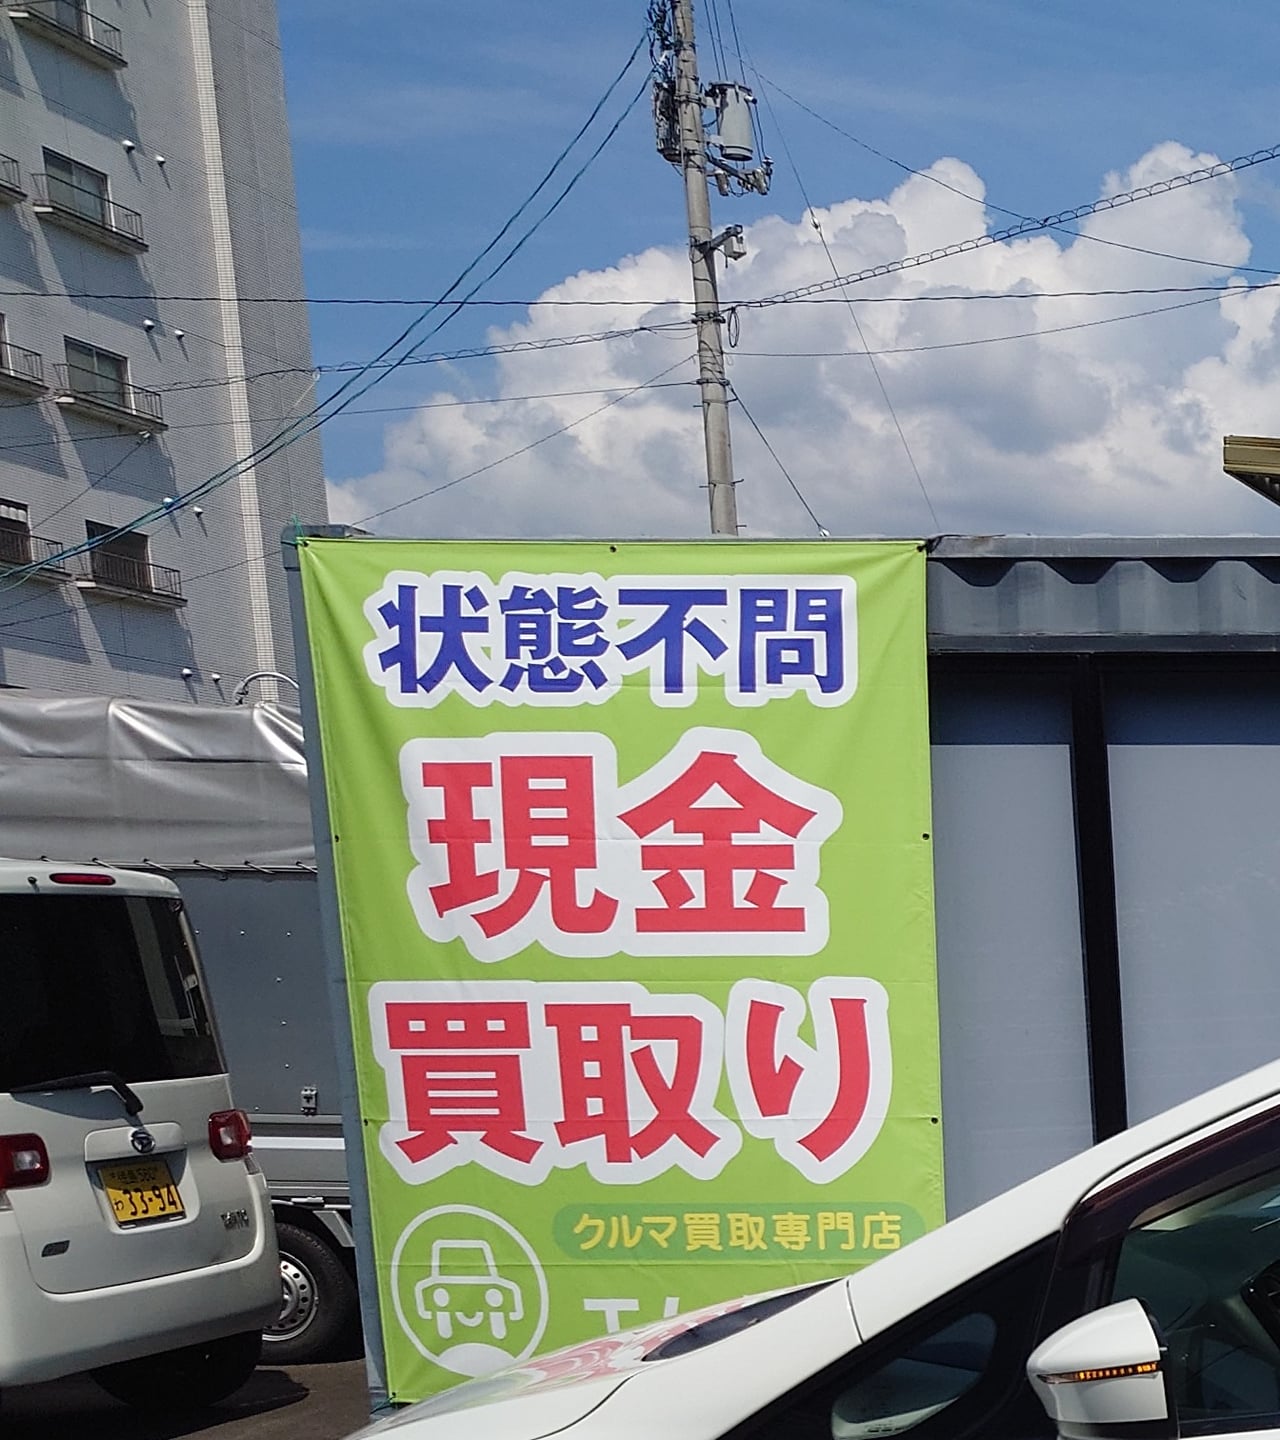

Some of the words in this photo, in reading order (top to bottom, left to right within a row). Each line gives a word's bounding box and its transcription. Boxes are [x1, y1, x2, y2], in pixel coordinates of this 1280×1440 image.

[378, 585, 844, 695] 状態不問
[420, 751, 819, 940] 現金
[385, 998, 872, 1165] 買取り
[573, 1211, 902, 1251] クルマ買取専門店
